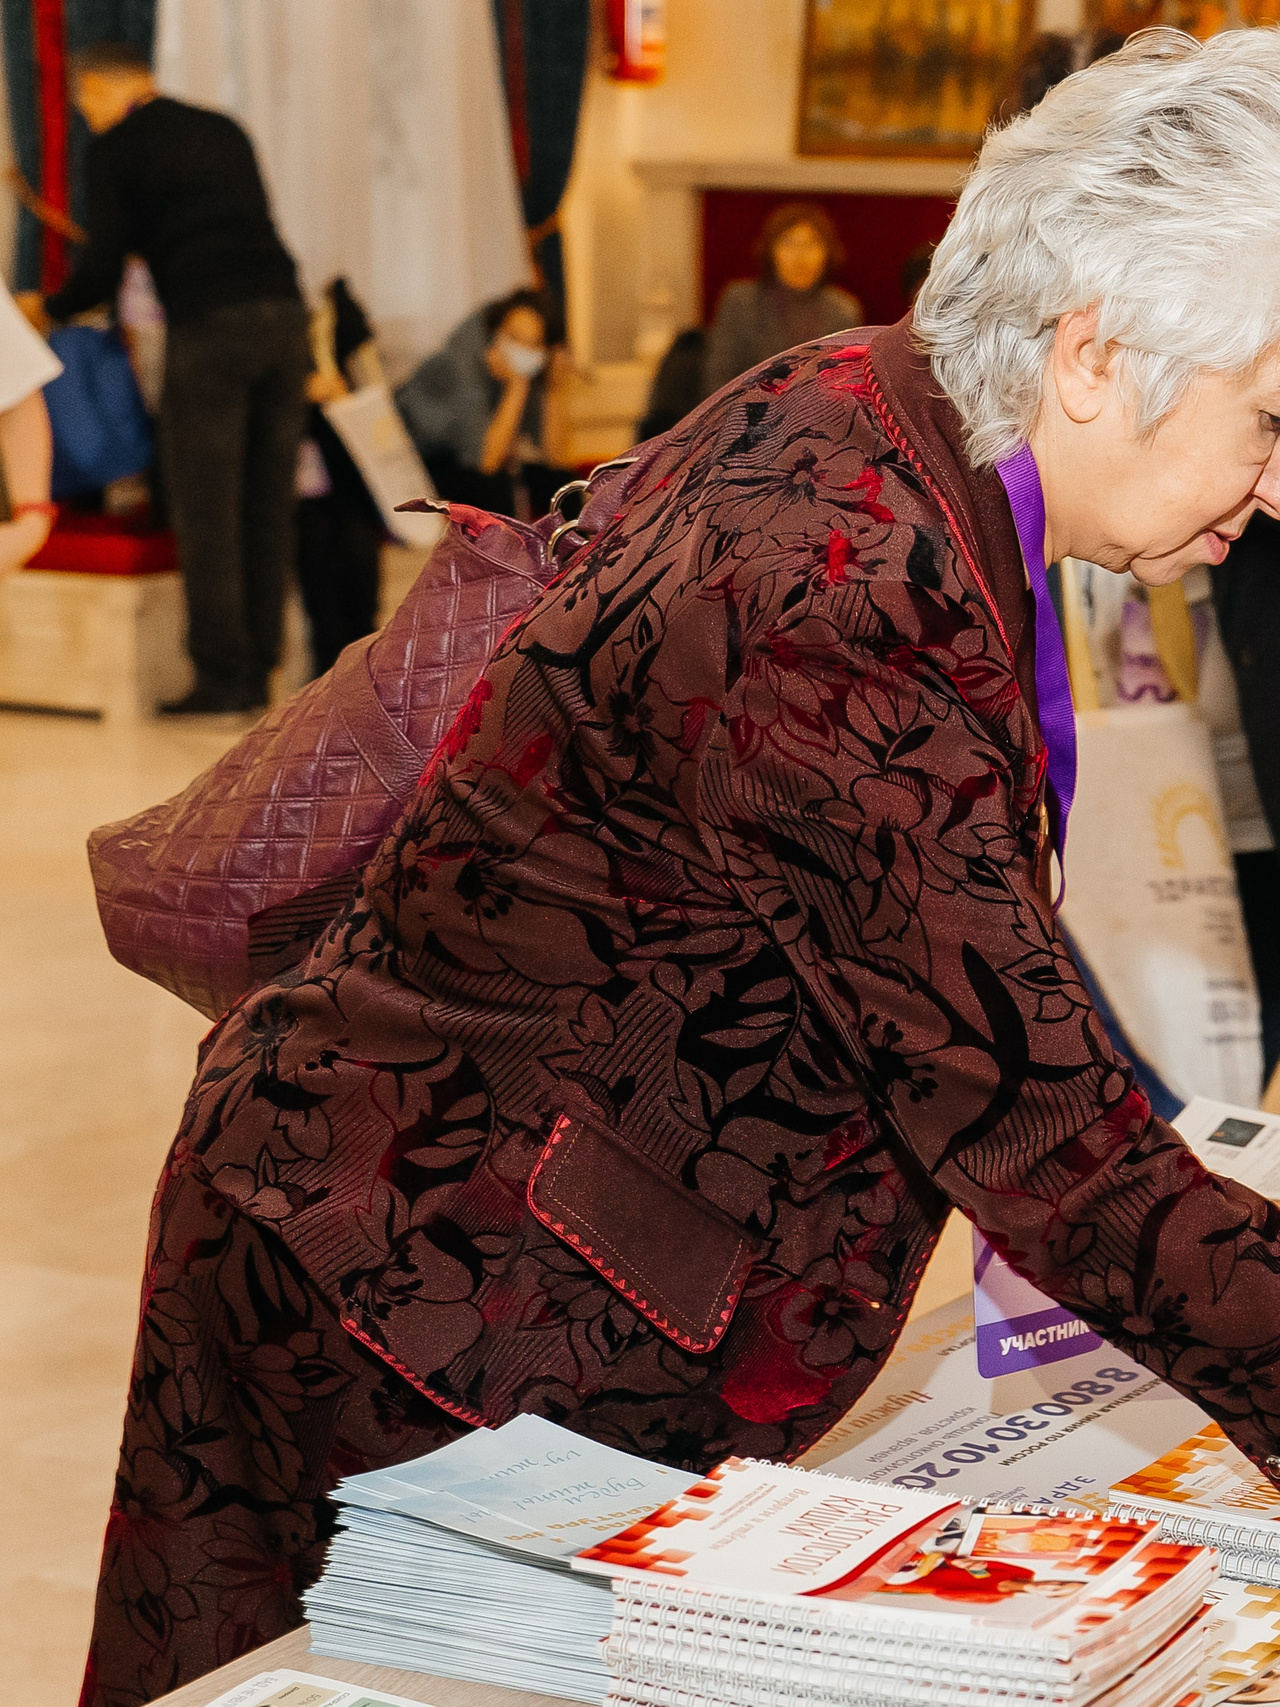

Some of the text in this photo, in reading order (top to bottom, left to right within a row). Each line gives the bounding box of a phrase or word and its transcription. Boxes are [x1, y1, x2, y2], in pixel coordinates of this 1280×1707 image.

[999, 1318, 1091, 1355] УЧАСТНИК
[848, 1389, 934, 1429] Нужна
[999, 1378, 1162, 1467] ЕСПЛАТНАЯ ЛИНИЯ ПО РОССИИ
[861, 1412, 1004, 1481] Помощь онкопсихол
[892, 1367, 1139, 1491] 8 800 30 10 20
[865, 1437, 918, 1464] врачей
[512, 1481, 597, 1511] жить!
[562, 1476, 650, 1505] Будем
[1027, 1475, 1097, 1507] ЗДРА
[546, 1503, 664, 1530] ТЕРАТУРА
[778, 1494, 864, 1538] КИШКИ
[770, 1501, 904, 1576] РАК ТОЛСТОЙ
